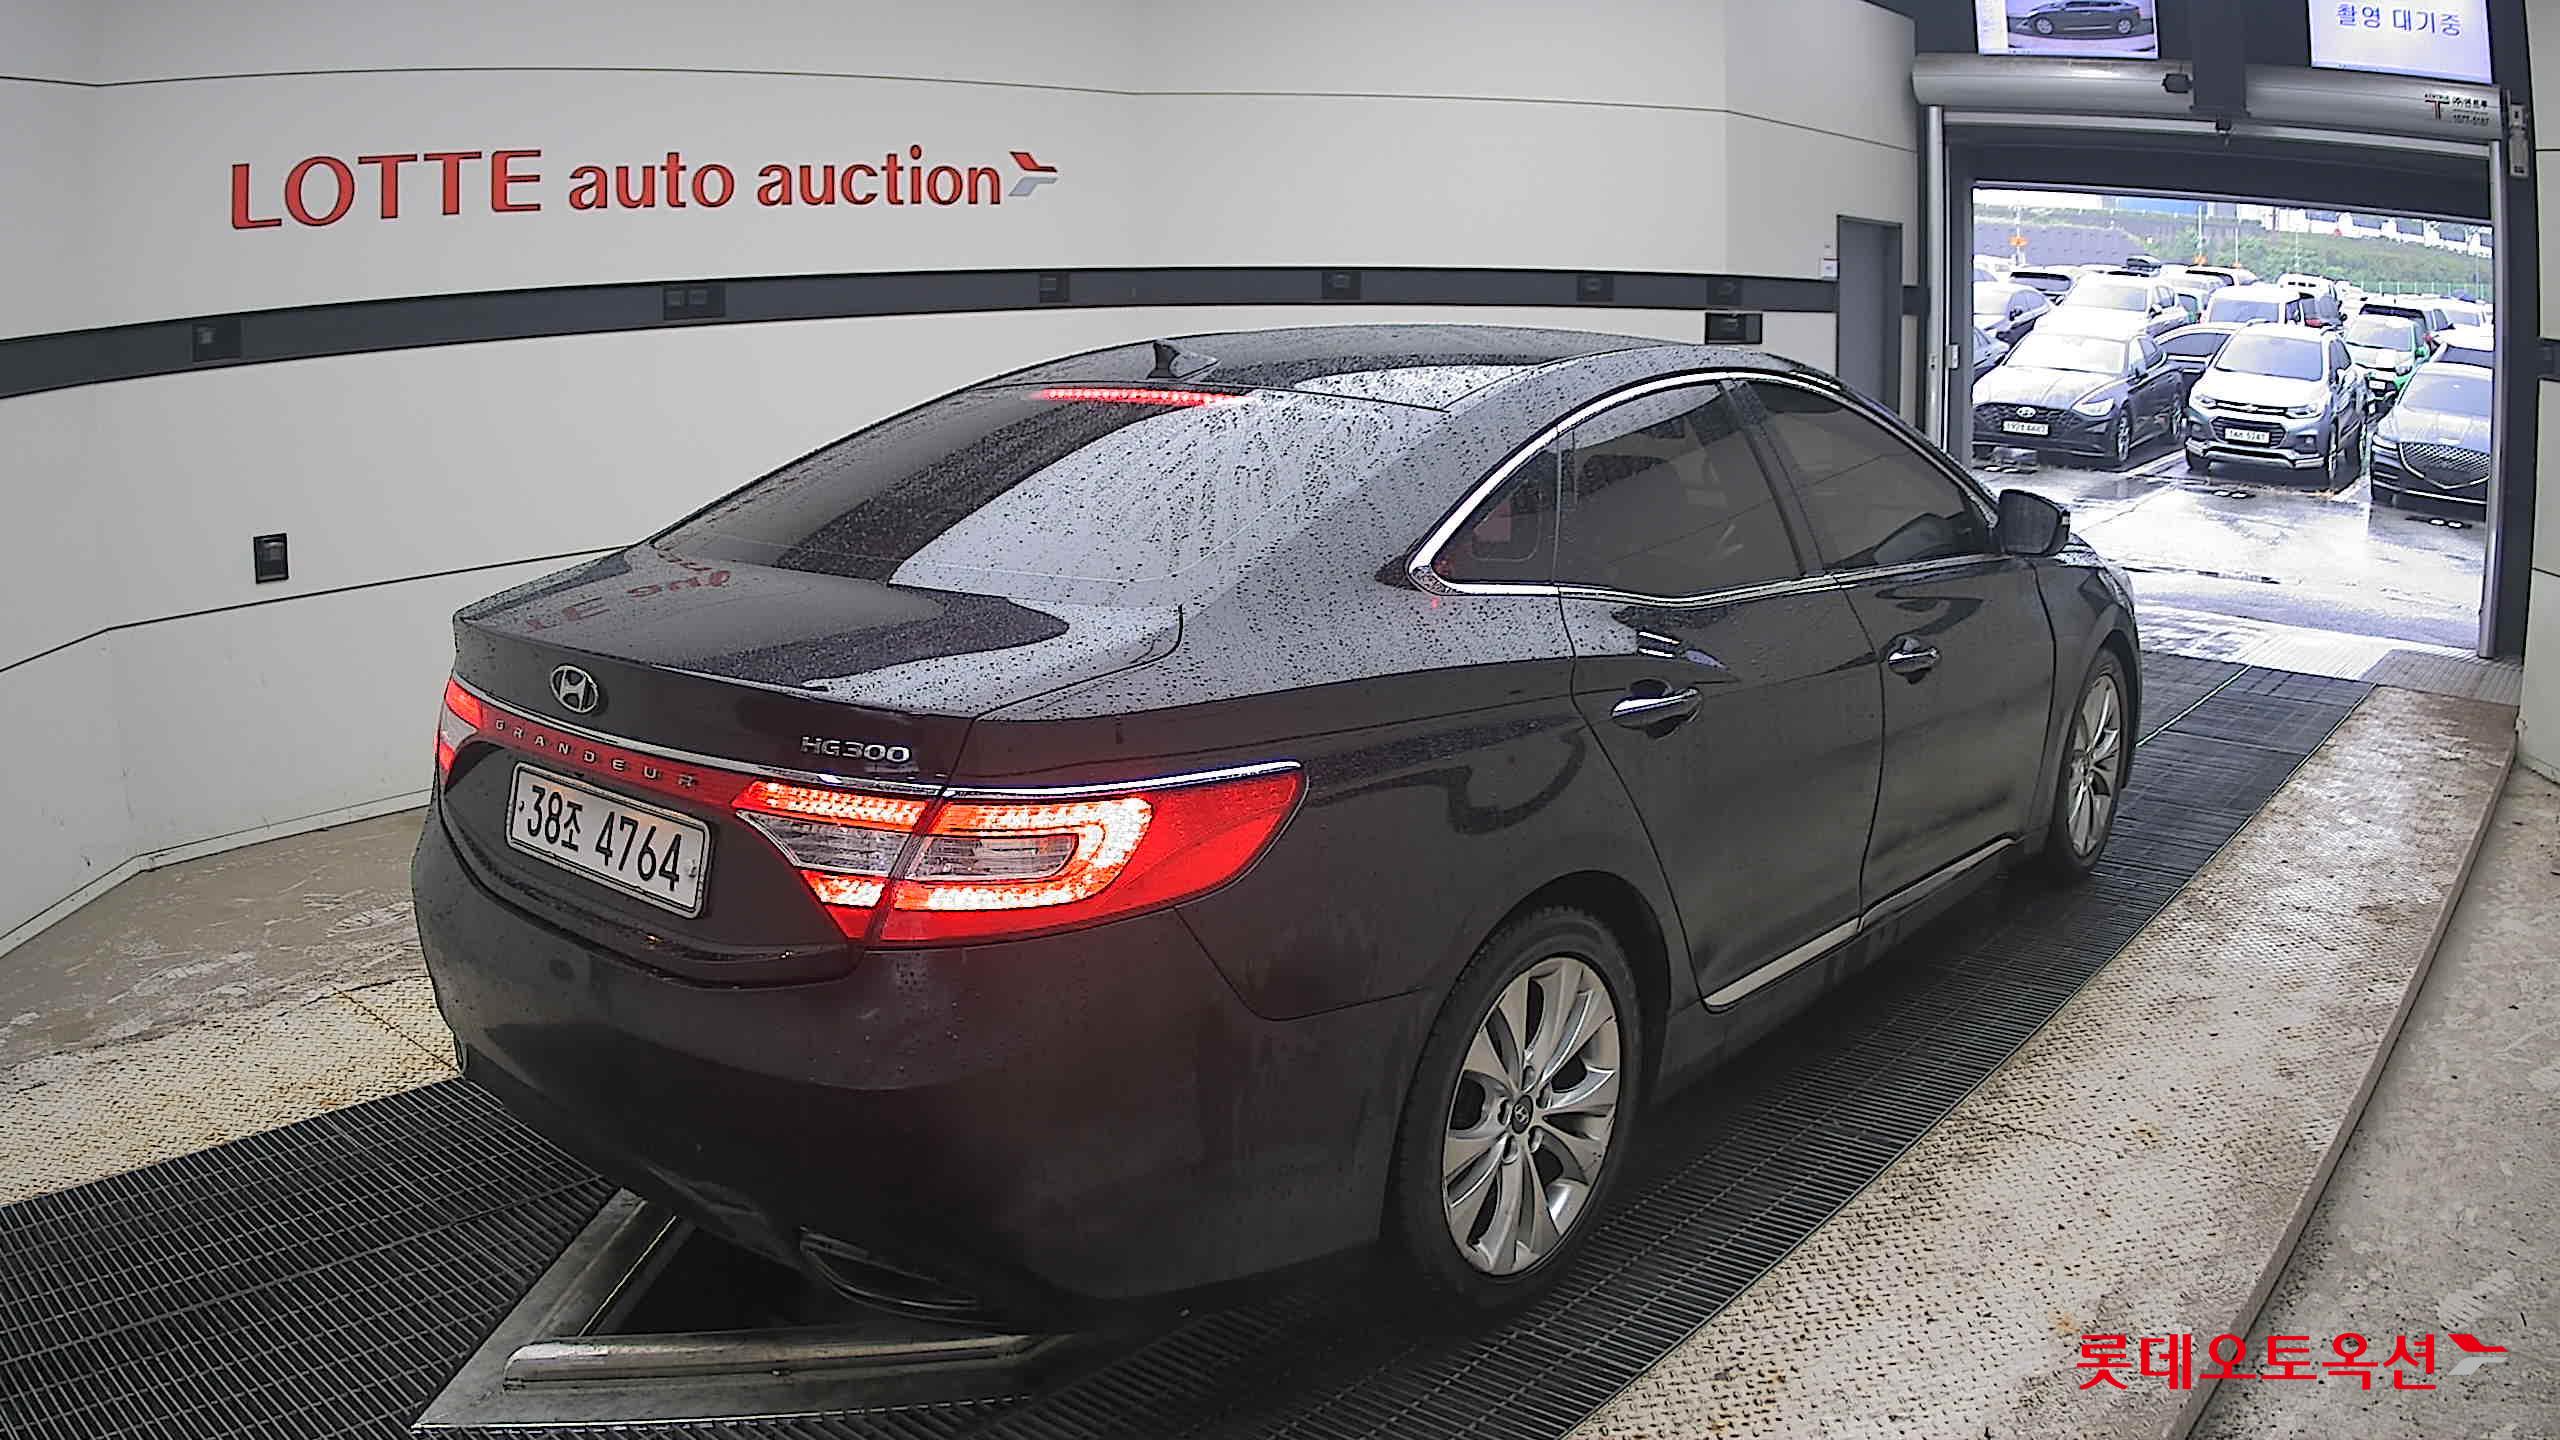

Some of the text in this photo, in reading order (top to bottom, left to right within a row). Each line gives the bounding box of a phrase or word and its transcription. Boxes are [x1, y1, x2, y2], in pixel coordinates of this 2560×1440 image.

[2337, 3, 2461, 37] 촬영 대기중
[231, 144, 1002, 230] LOTTE auto auction
[495, 718, 699, 789] GRANDEUR
[801, 735, 911, 762] HG300
[526, 784, 683, 892] 38조 4764
